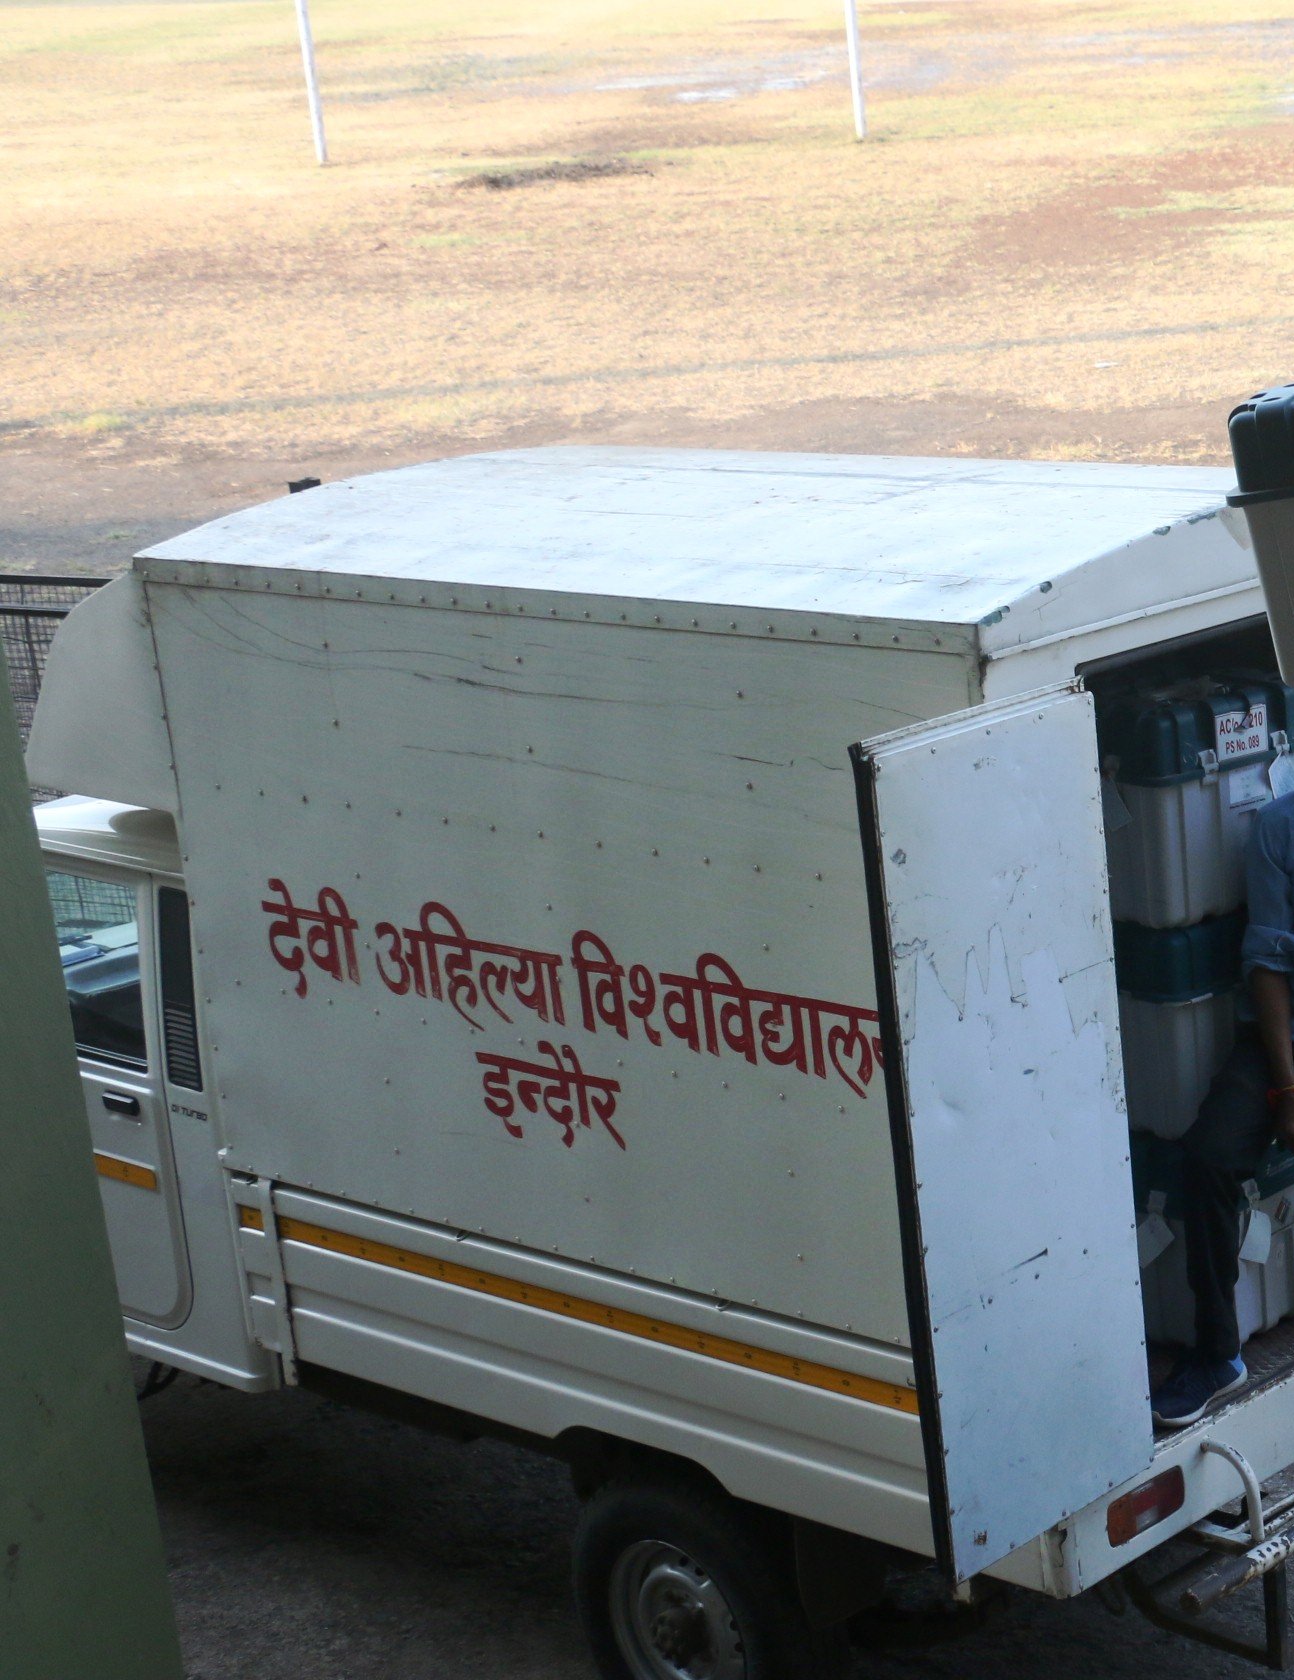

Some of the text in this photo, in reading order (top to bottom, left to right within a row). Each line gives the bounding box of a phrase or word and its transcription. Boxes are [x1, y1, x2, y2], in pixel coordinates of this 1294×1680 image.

[1220, 719, 1231, 735] AC
[1249, 711, 1263, 728] 210
[1226, 741, 1235, 754] PS
[1236, 739, 1247, 752] No.
[261, 878, 884, 1099] देवी अहिल्या विश्वविद्याल
[476, 1040, 626, 1151] इन्दौर
